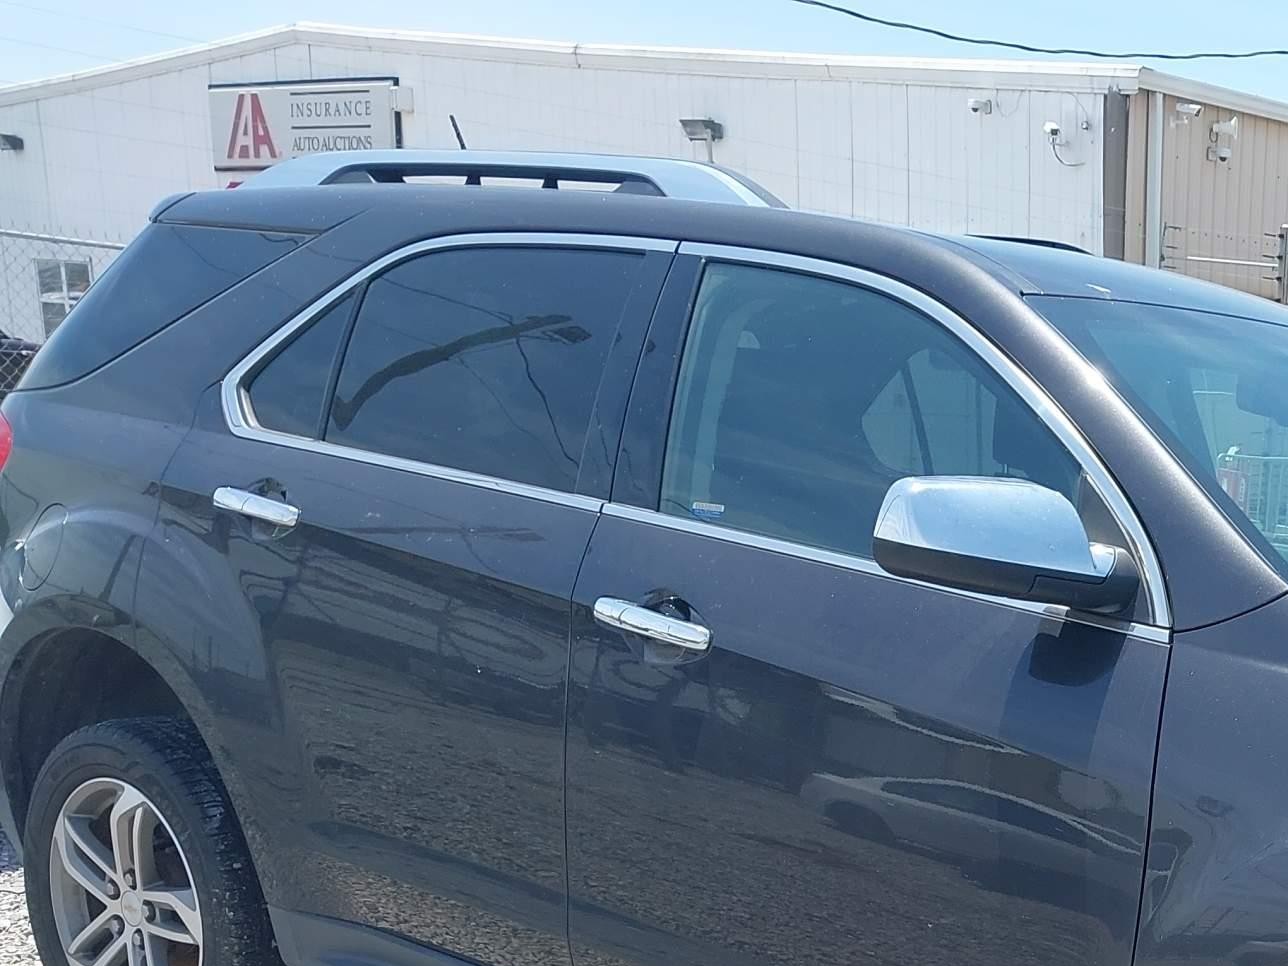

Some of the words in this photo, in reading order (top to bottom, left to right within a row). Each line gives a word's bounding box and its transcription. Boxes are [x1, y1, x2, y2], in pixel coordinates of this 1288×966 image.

[289, 100, 373, 118] INSURANCE
[291, 136, 321, 152] AUTO
[320, 135, 373, 151] AUCTIONS
